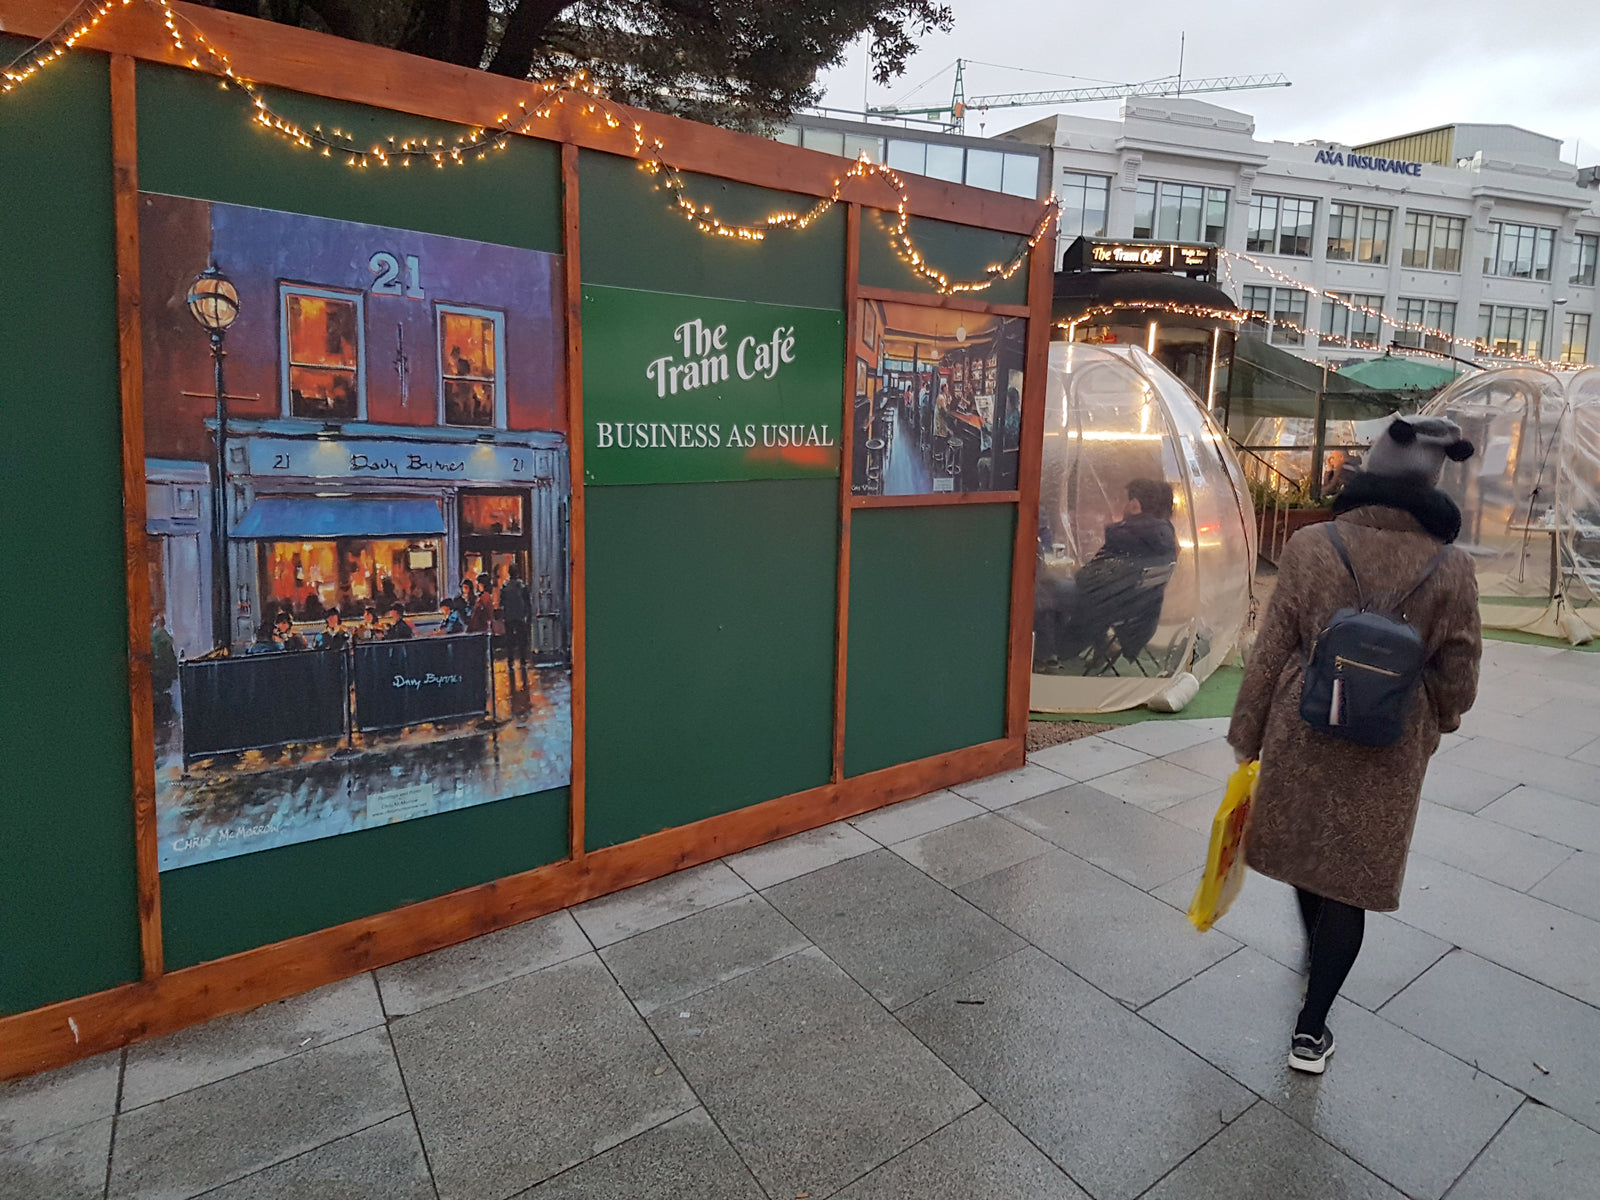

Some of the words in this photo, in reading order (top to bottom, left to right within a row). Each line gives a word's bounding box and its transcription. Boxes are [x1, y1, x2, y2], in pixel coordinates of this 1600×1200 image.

[1314, 149, 1344, 167] AXA
[1347, 153, 1422, 177] INSURANCE
[1092, 247, 1112, 261] The
[1113, 248, 1139, 262] Tram
[1140, 248, 1163, 266] Café
[368, 250, 425, 301] 21
[673, 318, 728, 358] The
[646, 353, 730, 399] Tram
[736, 326, 796, 380] Café
[596, 422, 721, 448] BUSINESS
[726, 424, 757, 448] AS
[761, 424, 834, 448] USUAL
[272, 453, 290, 470] 21
[512, 457, 525, 473] 21
